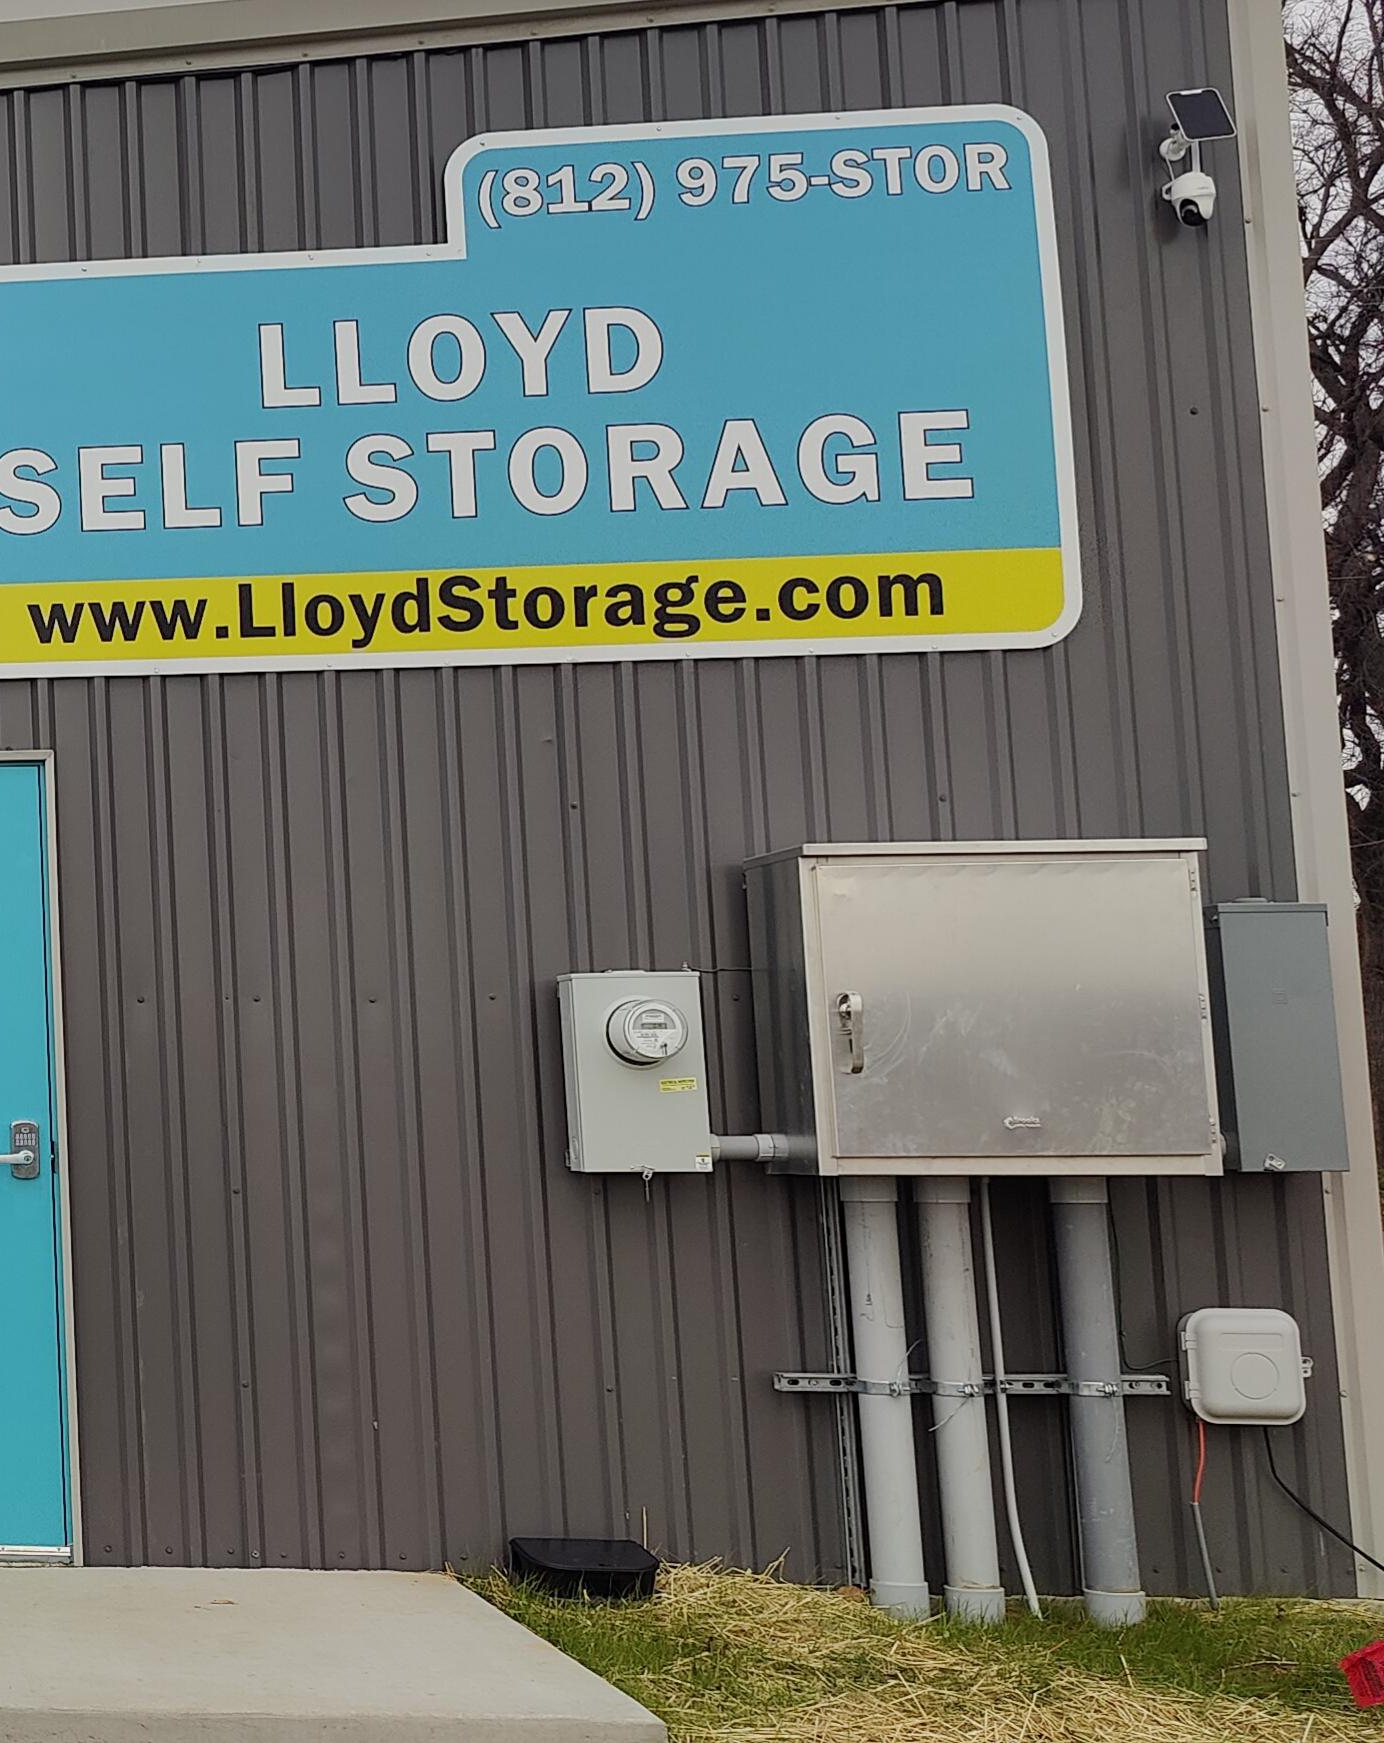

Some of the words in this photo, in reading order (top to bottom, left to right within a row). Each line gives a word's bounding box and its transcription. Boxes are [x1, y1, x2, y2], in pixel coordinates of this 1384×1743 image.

[479, 162, 655, 229] (812)
[677, 143, 1012, 206] 975-STOR
[257, 306, 664, 409] LLOYD
[343, 410, 975, 522] STORAGE
[27, 573, 944, 648] www.LloydStorage.com
